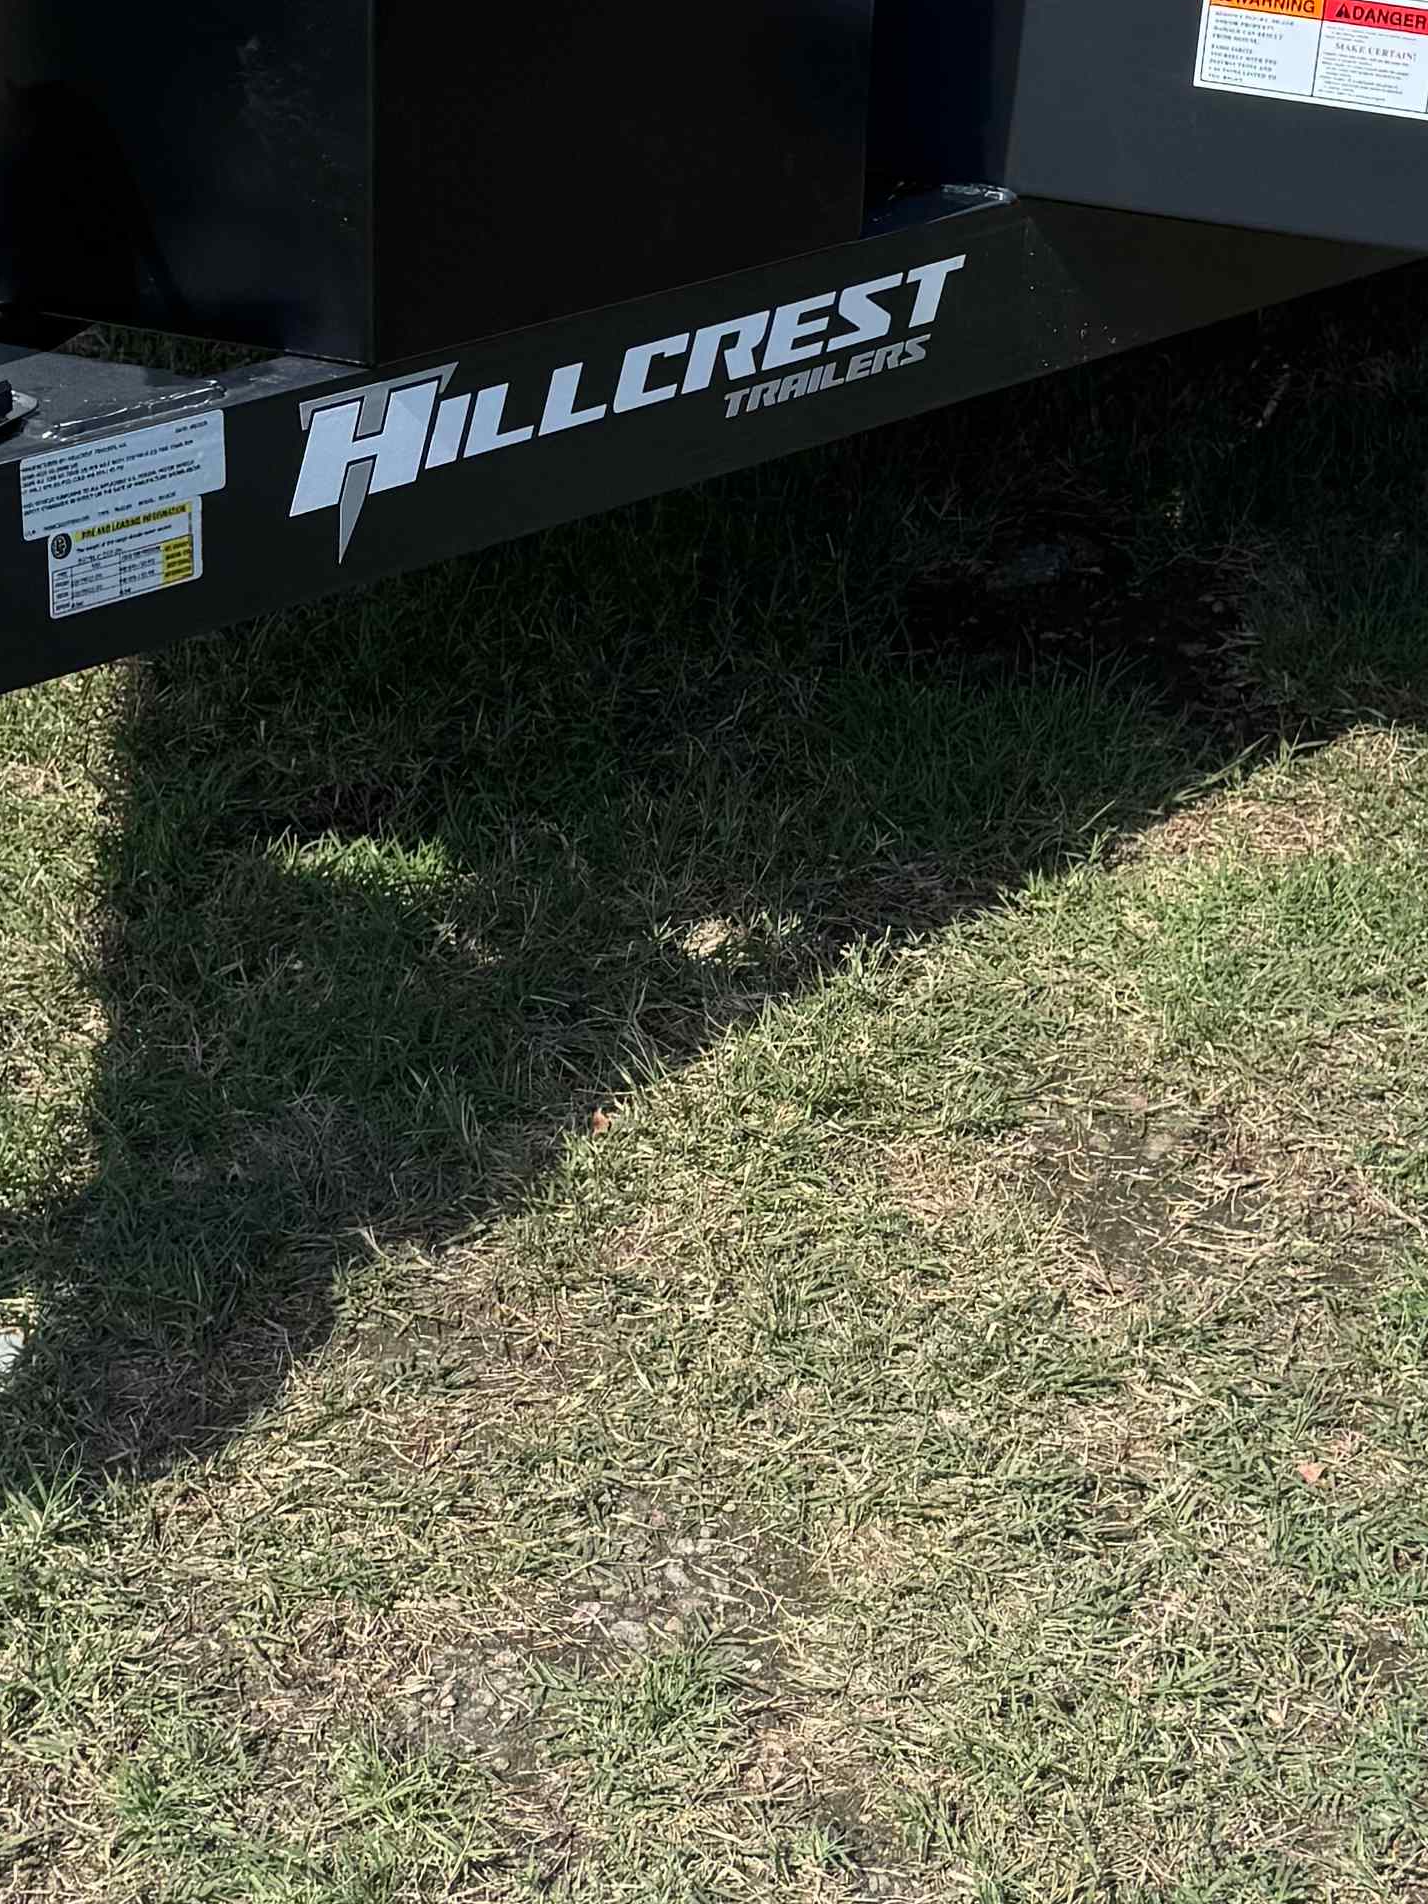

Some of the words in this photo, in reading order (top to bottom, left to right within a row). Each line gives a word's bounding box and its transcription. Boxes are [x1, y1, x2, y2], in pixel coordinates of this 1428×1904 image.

[1353, 5, 1427, 30] DANGER
[289, 254, 966, 517] HILLCREST
[724, 333, 931, 419] TRAILERS
